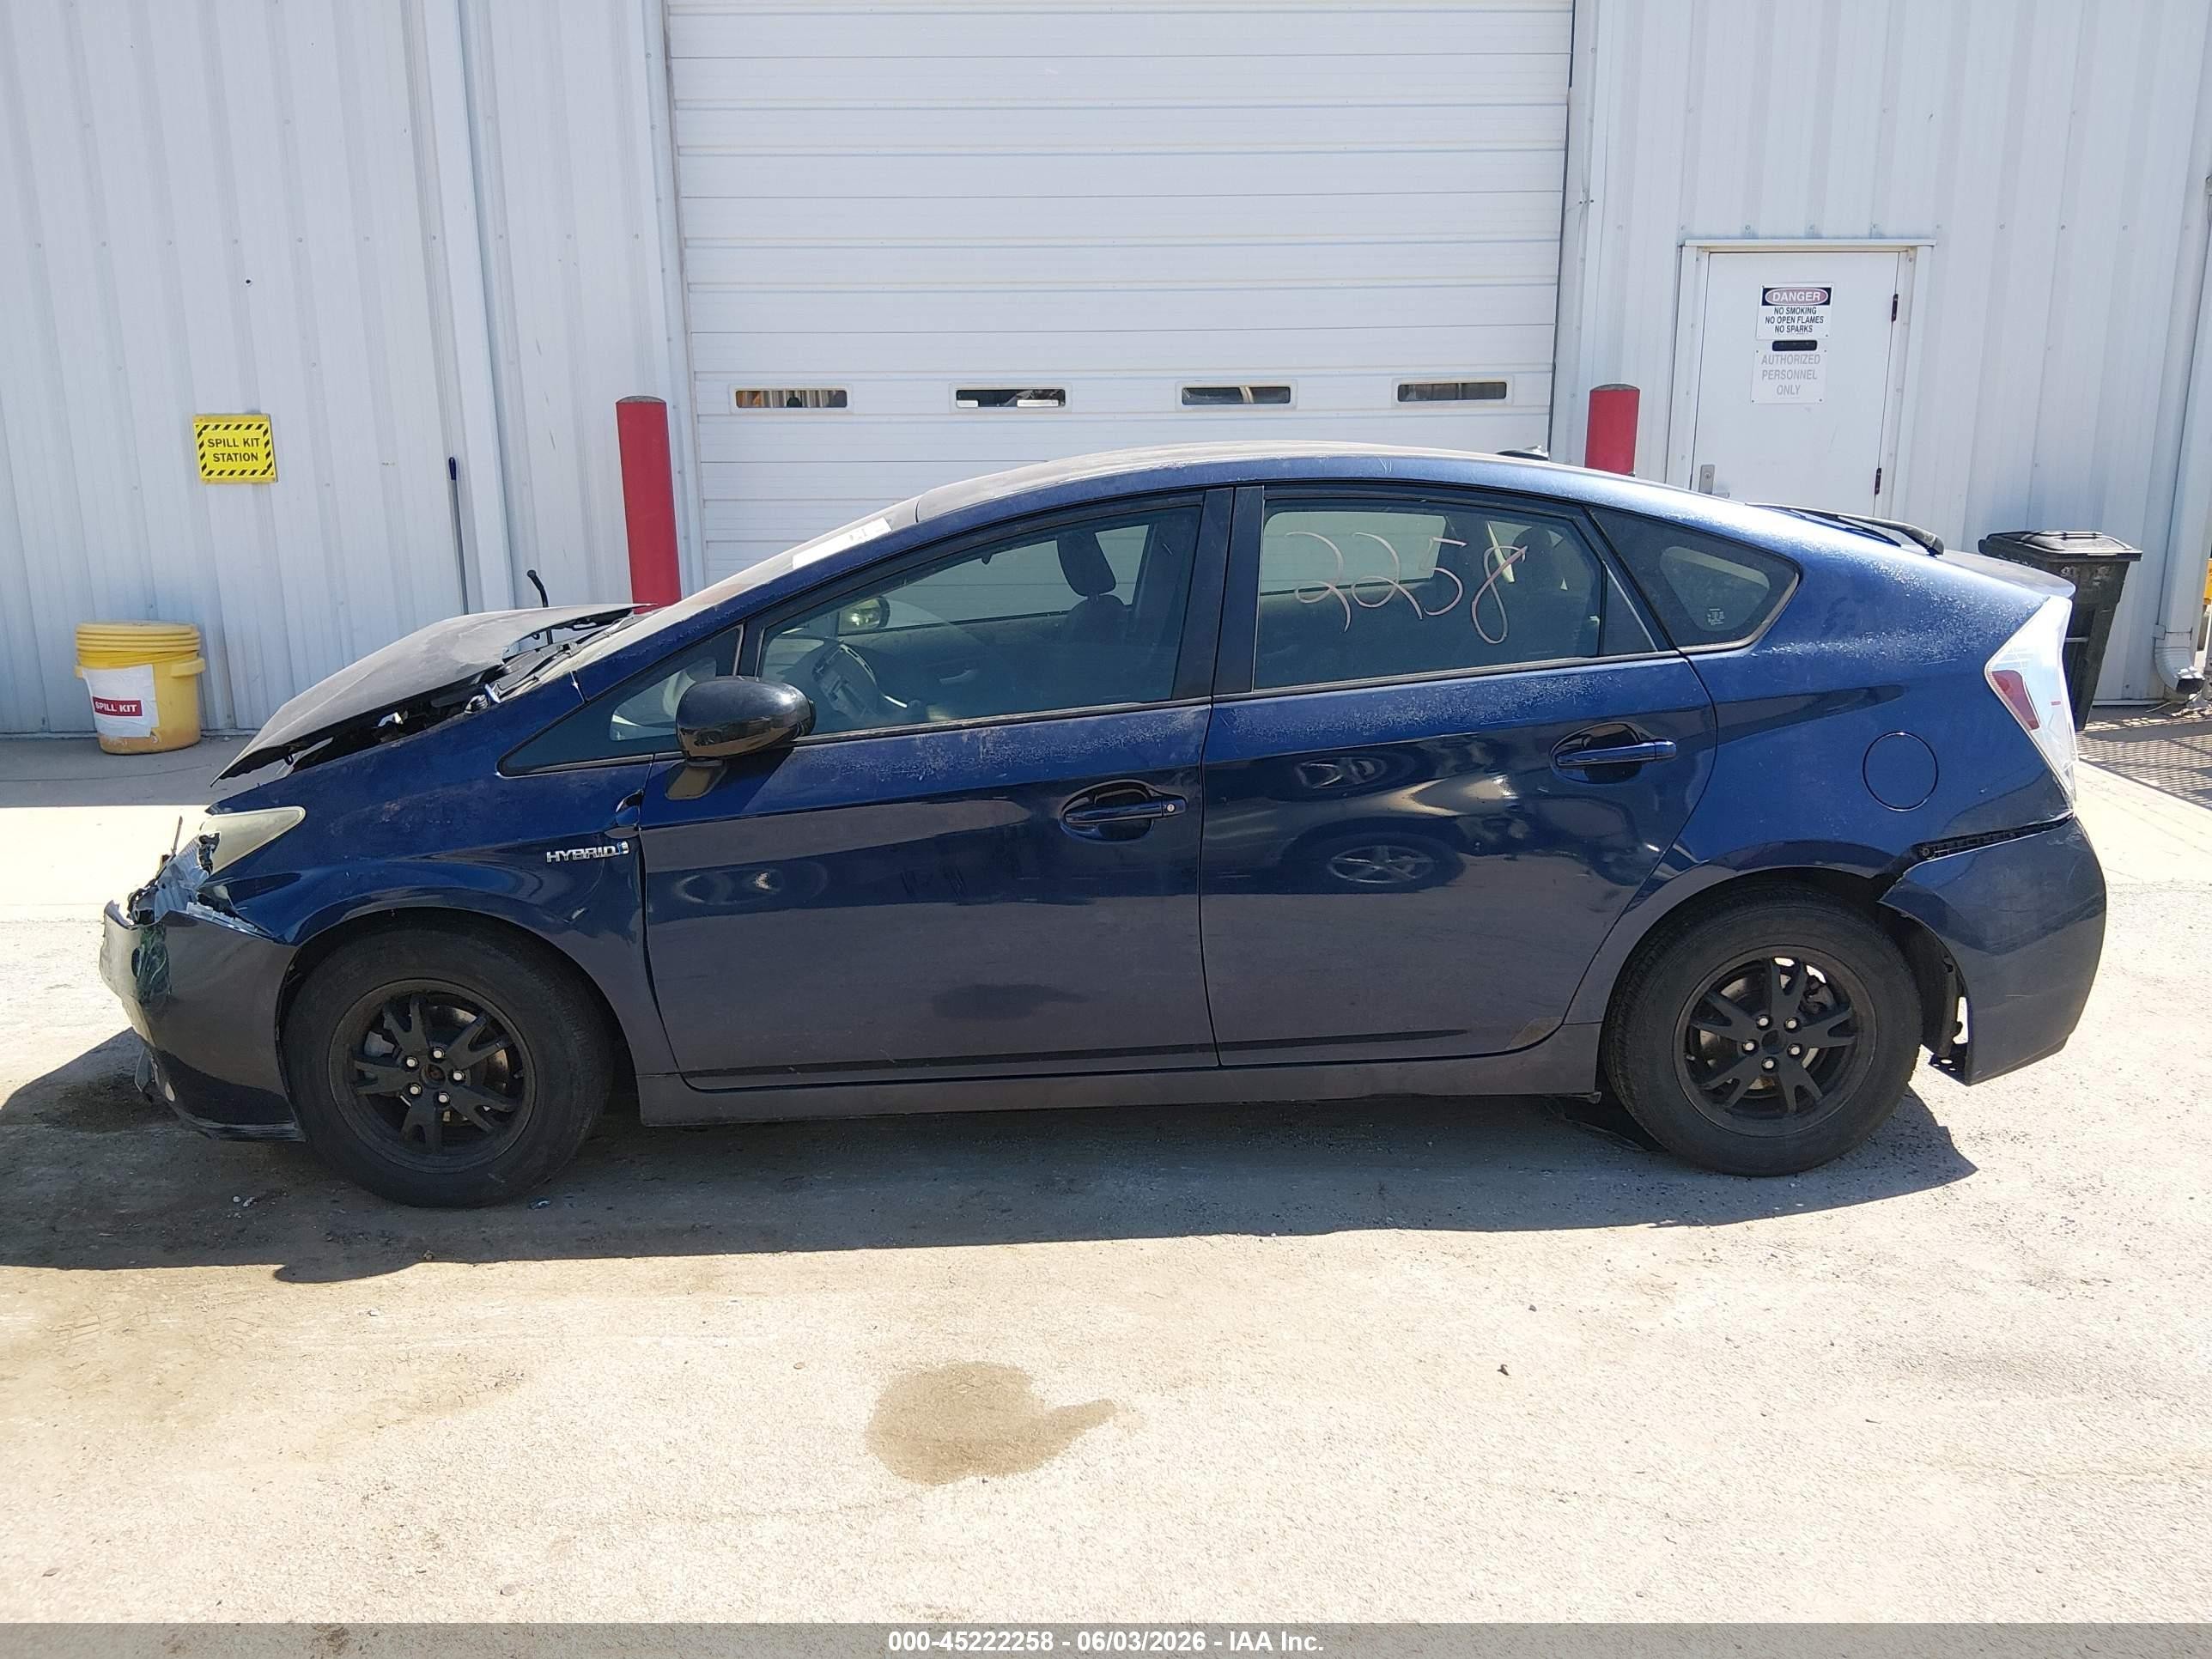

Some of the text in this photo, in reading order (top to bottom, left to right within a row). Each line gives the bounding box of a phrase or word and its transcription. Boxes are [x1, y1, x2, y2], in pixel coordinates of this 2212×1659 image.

[1772, 291, 1821, 301] DANGER
[1774, 307, 1817, 315] NO SMOKING
[1765, 315, 1824, 325] NO OPEN FLAMES
[1774, 325, 1785, 334] NO
[1761, 354, 1821, 365] AUTHORIZED
[1762, 369, 1817, 380] PERSONNEL
[1776, 384, 1801, 396] ONLY
[207, 438, 260, 448] SPILL KIT
[213, 453, 258, 462] STATION
[1285, 532, 1528, 645] 2258
[95, 702, 117, 712] SPILL
[546, 845, 617, 863] HYBRID
